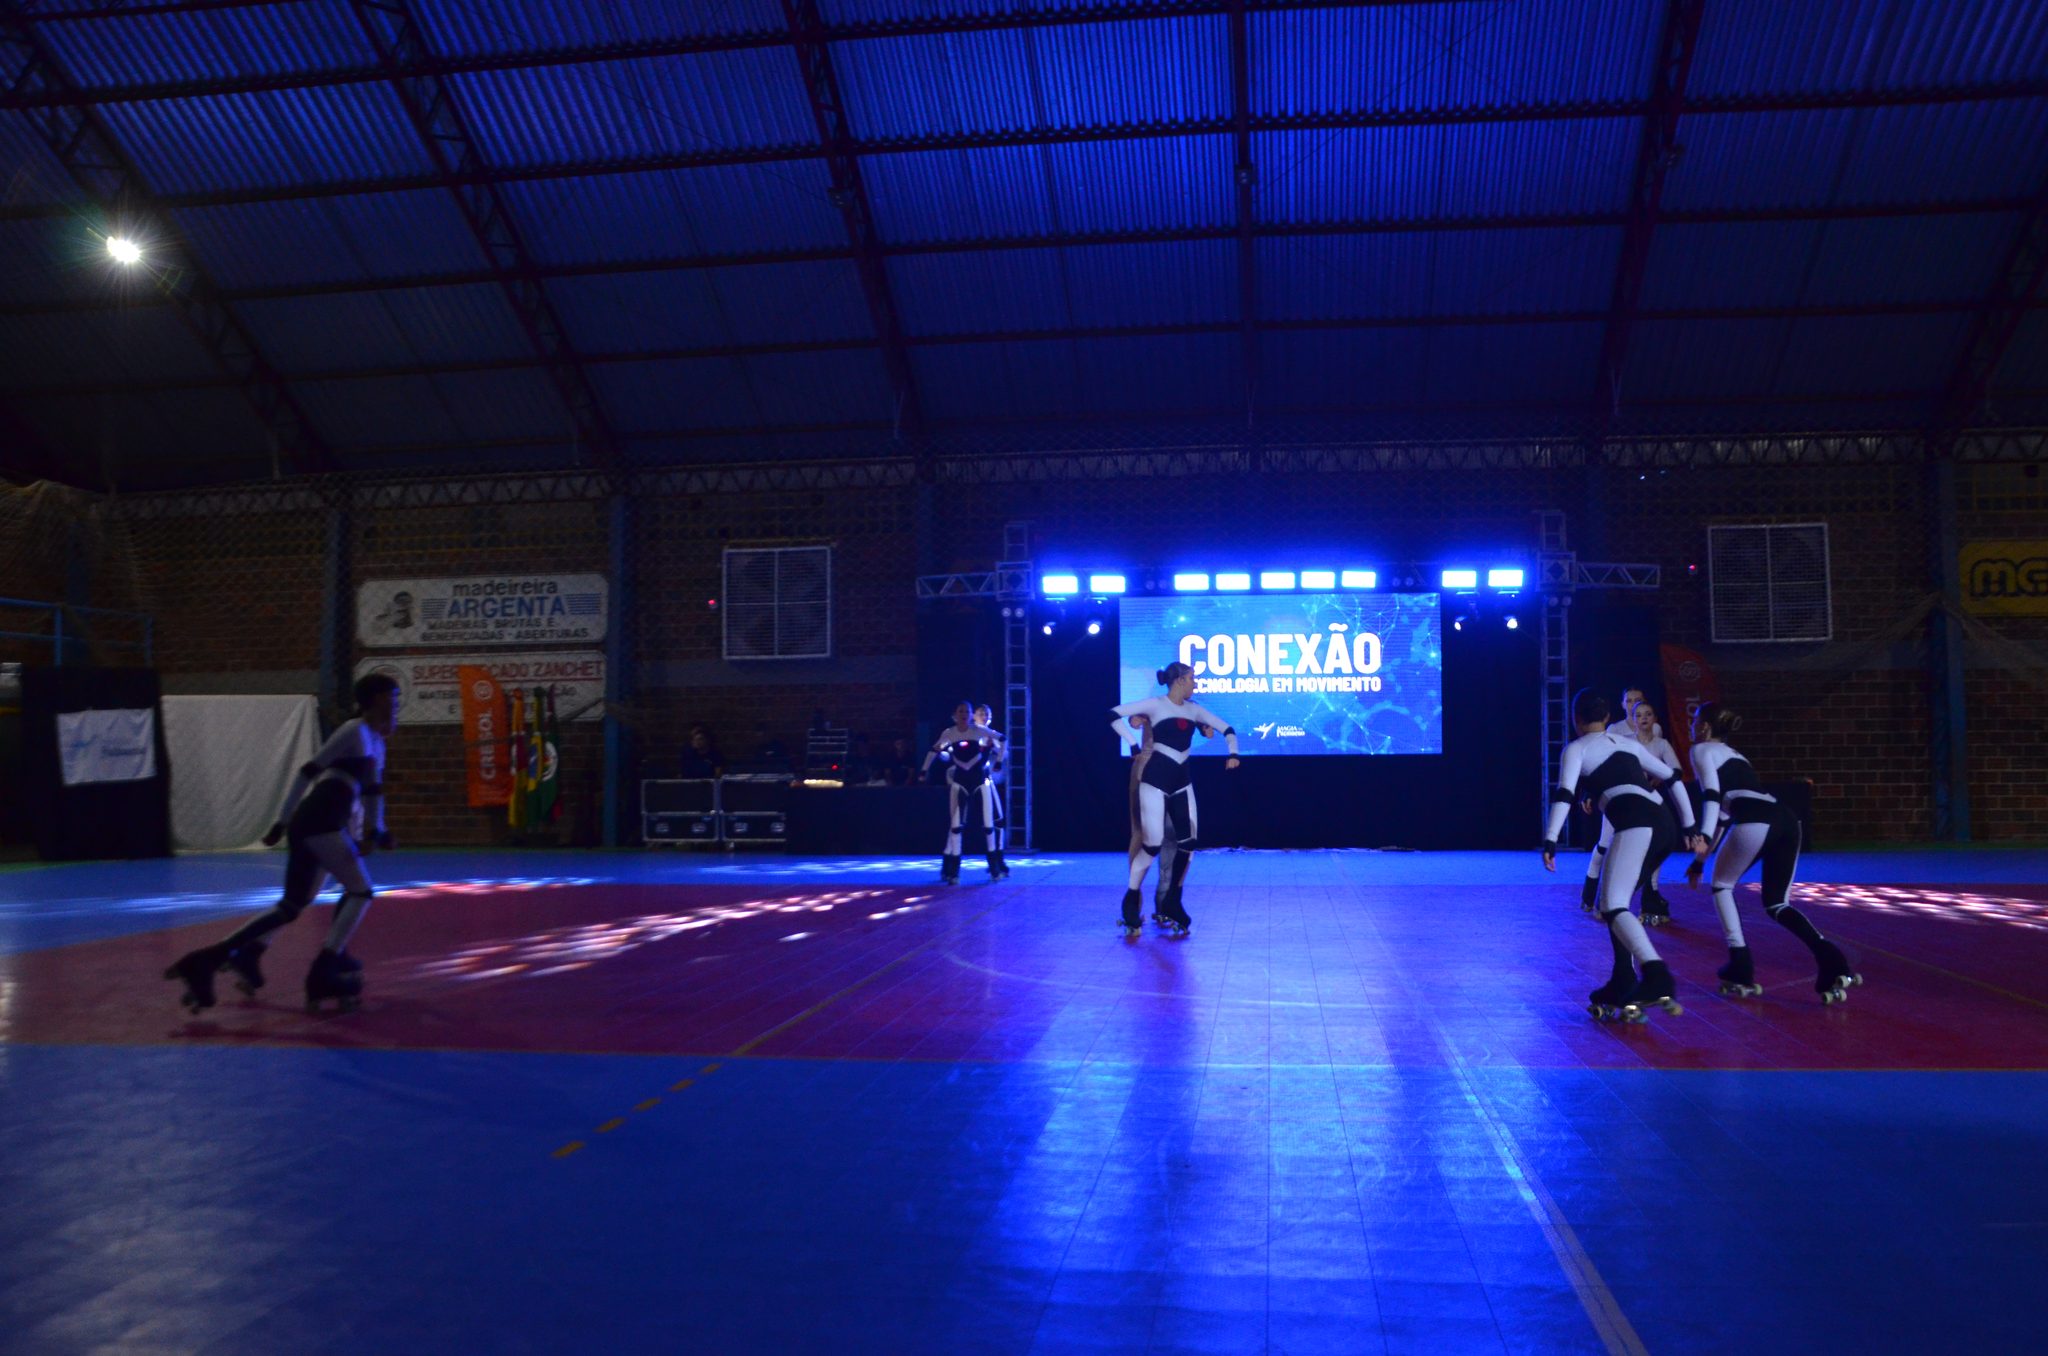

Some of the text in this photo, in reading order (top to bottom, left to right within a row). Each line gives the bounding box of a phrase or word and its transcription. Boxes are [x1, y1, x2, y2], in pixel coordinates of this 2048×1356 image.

[452, 580, 558, 596] madeireira
[448, 596, 565, 618] ARGENTA
[515, 628, 588, 640] ABERTURAS
[1179, 623, 1381, 675] CONEXÃO
[1193, 677, 1381, 693] CNOLOGIA EM MOVIMENTO
